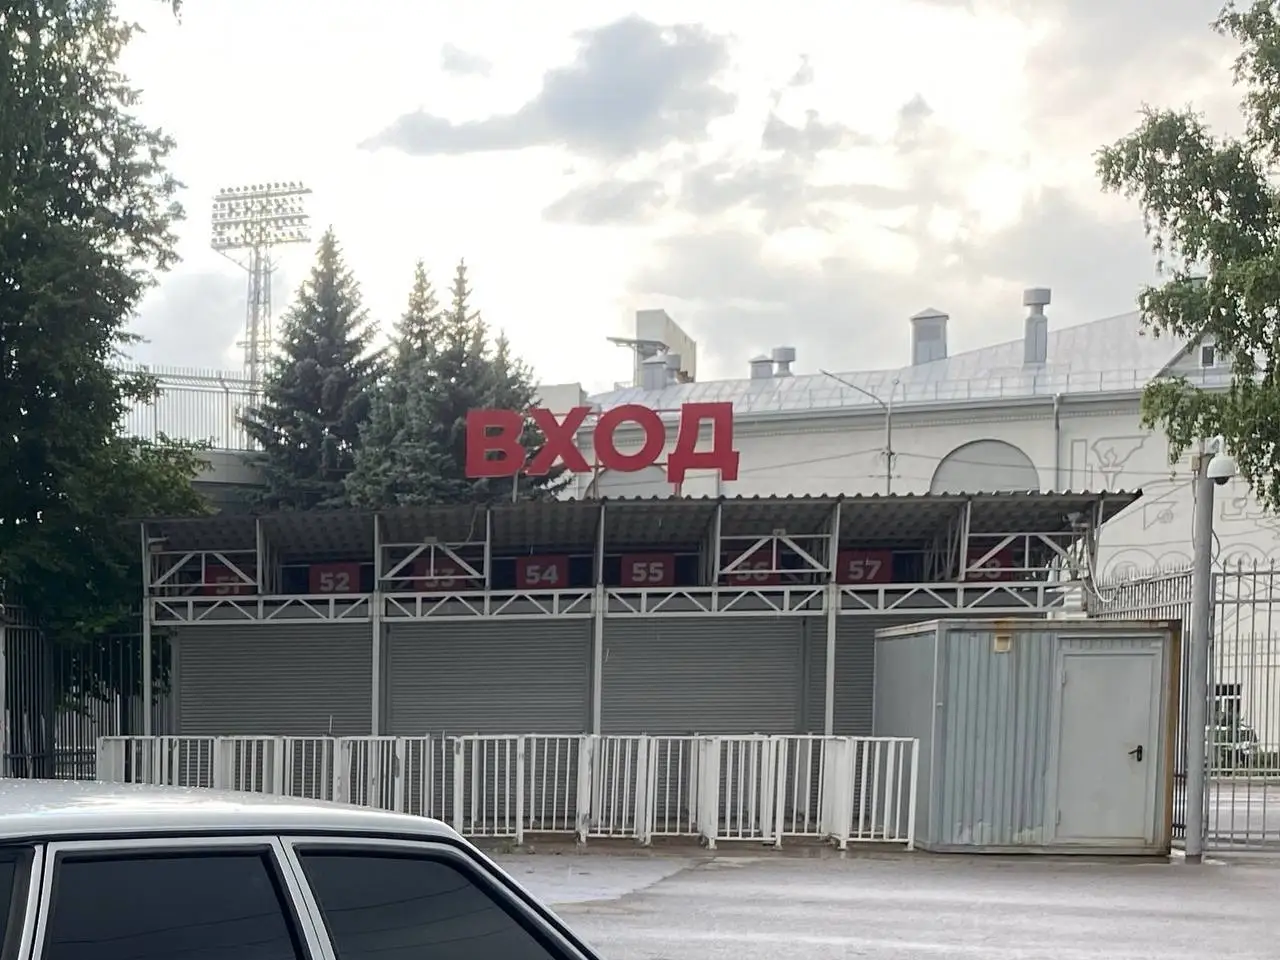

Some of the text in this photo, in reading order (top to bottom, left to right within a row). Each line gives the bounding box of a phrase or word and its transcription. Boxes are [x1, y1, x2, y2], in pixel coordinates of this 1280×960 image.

[465, 402, 740, 484] ВХОД
[424, 568, 456, 588] 53
[525, 564, 559, 584] 54
[632, 562, 665, 582] 55
[735, 561, 770, 581] 56
[848, 560, 882, 580] 57
[216, 576, 240, 595] 51
[320, 572, 350, 593] 52
